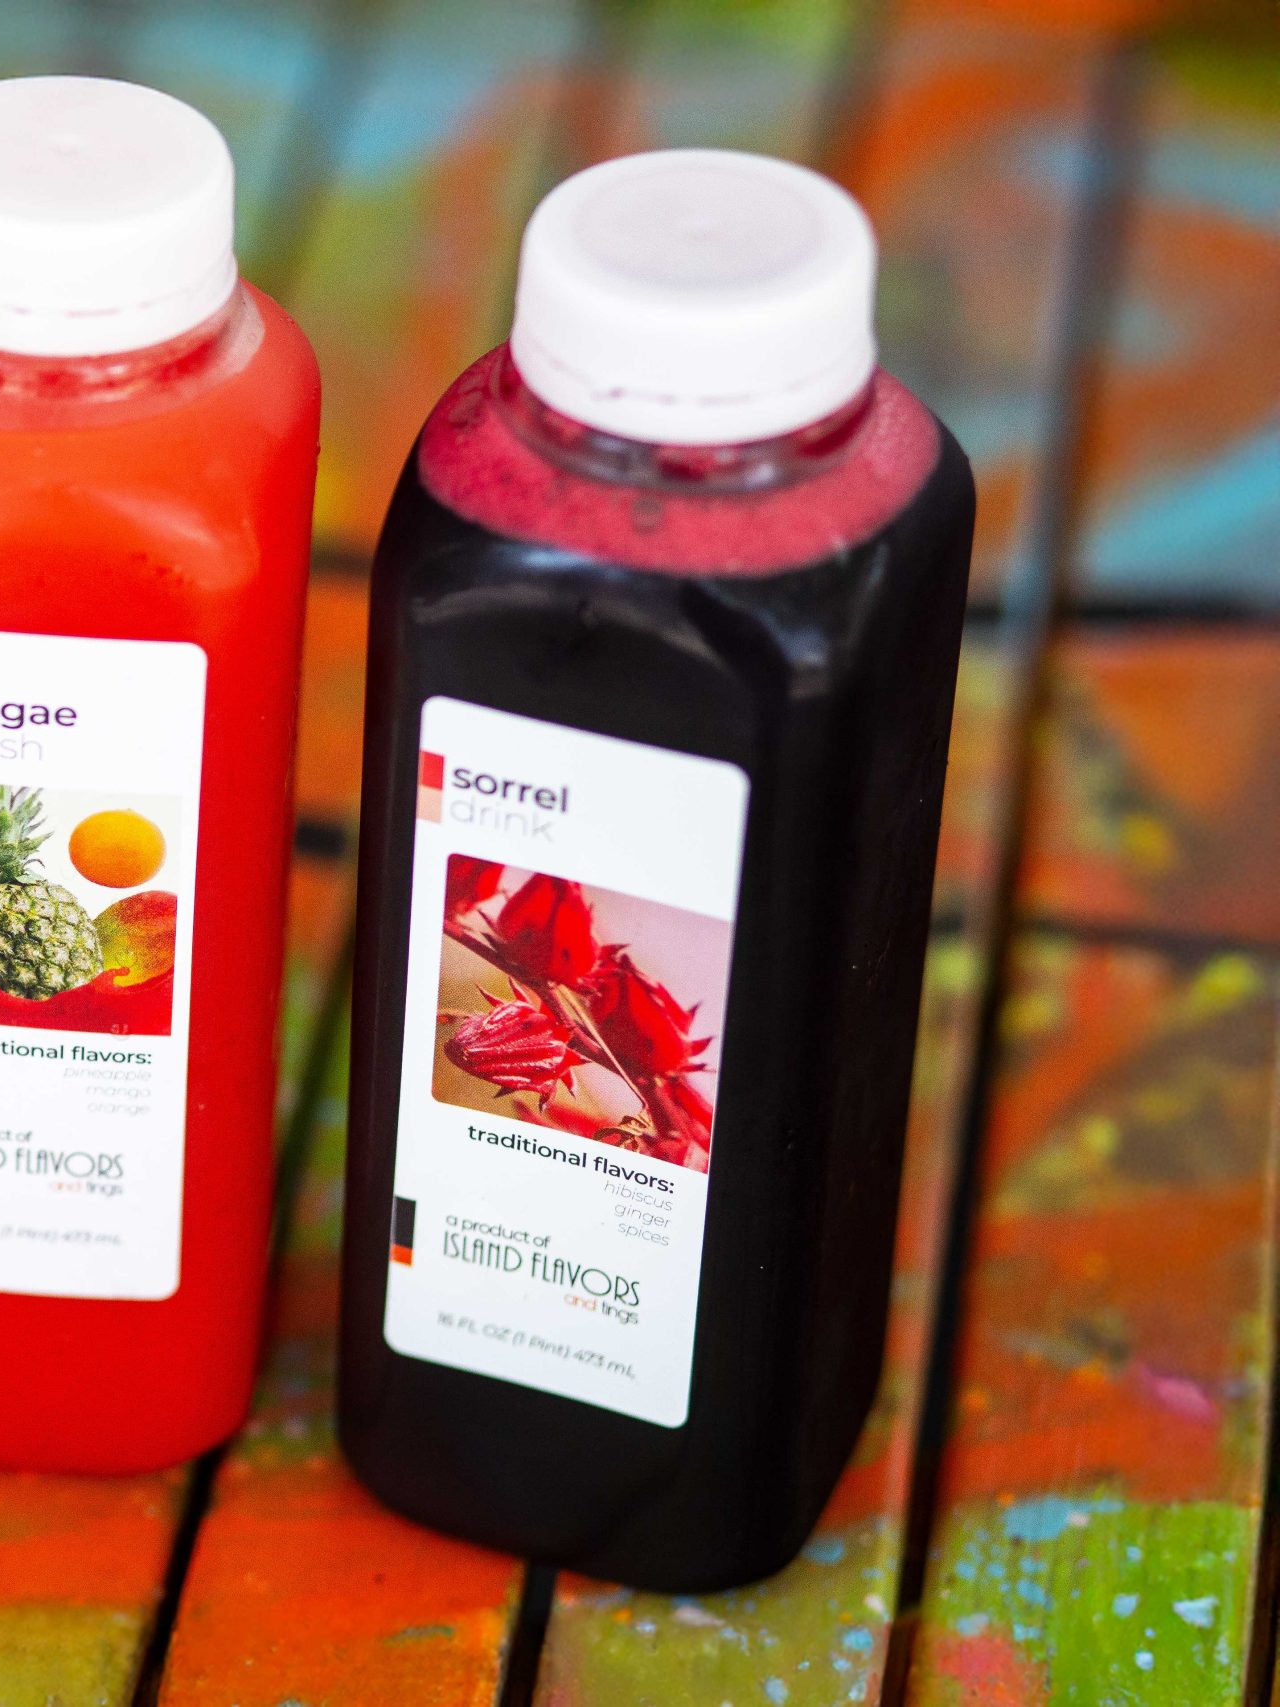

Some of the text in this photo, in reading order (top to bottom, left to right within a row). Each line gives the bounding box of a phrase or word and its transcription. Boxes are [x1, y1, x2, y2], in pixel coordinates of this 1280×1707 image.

[452, 768, 568, 814] sorrel
[449, 796, 554, 843] drink
[71, 1046, 153, 1066] flavors:
[15, 1130, 33, 1143] of
[14, 1146, 125, 1180] FLAVORS
[468, 1125, 675, 1194] traditional flavors:
[603, 1179, 673, 1211] hibiscus
[445, 1214, 552, 1249] a product of
[613, 1202, 670, 1229] ginger
[617, 1221, 671, 1247] spices
[442, 1230, 640, 1307] ISLAND FLAVORS
[562, 1293, 639, 1326] and tings
